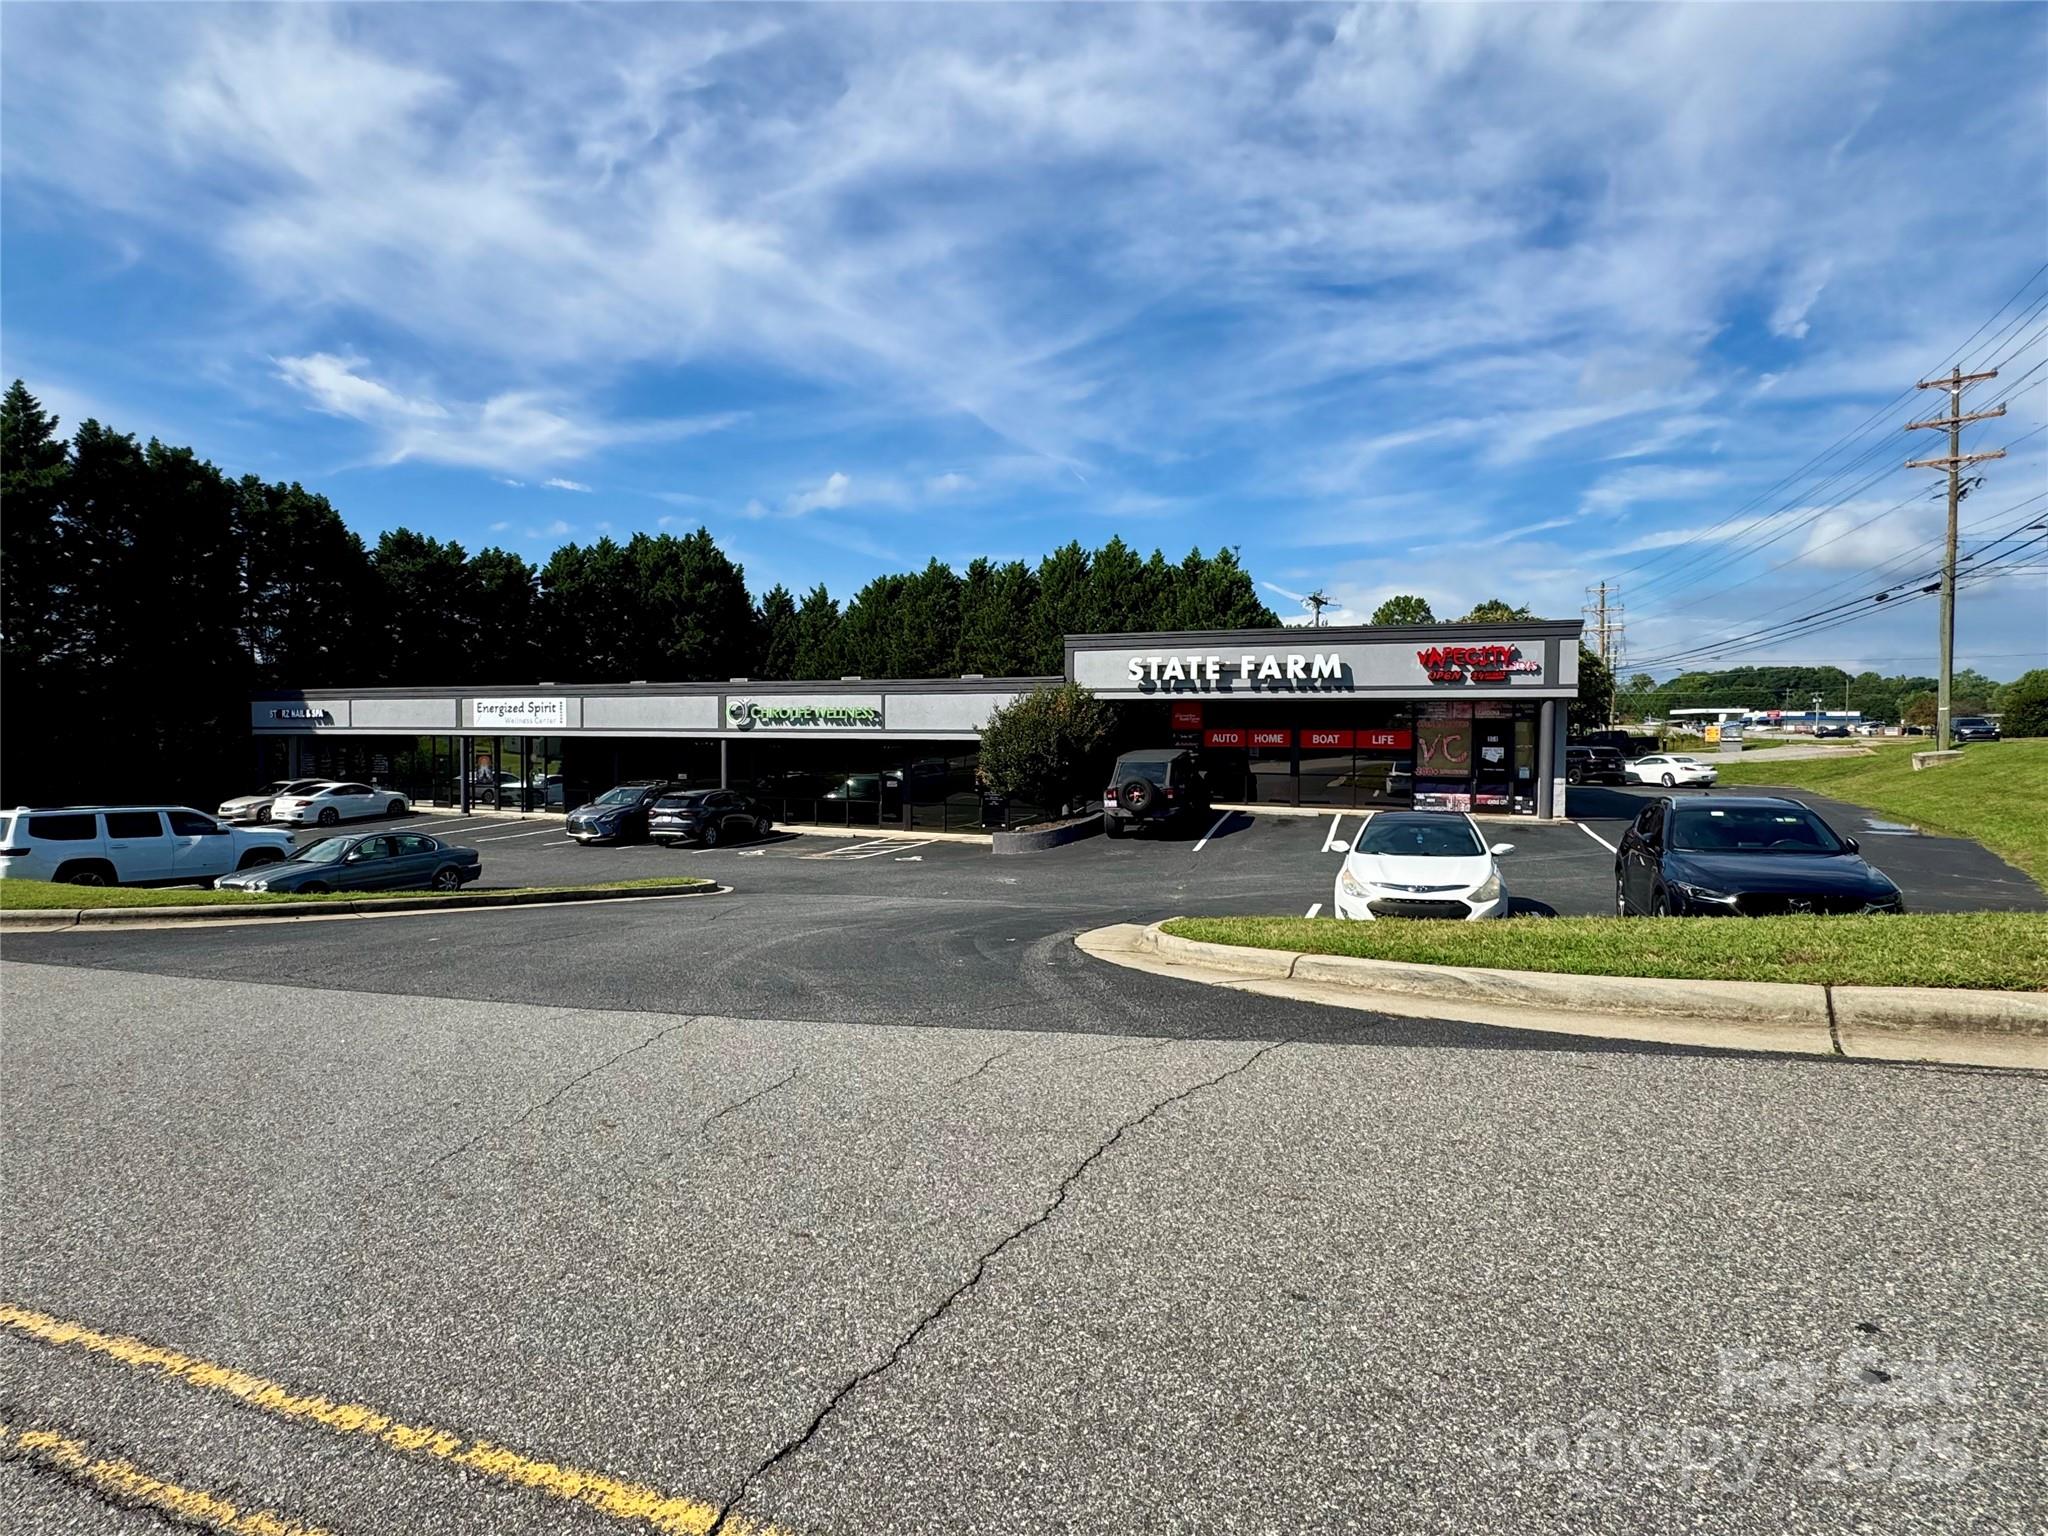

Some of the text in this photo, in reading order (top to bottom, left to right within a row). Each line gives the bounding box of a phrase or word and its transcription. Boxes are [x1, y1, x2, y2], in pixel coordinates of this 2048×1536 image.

[1128, 653, 1342, 681] STATE FARM
[270, 709, 324, 719] STRZ NAIL & SPA
[476, 701, 557, 717] Energized Spirit
[815, 706, 876, 719] WELLNESS
[505, 717, 557, 725] Wellness Center
[1212, 733, 1239, 744] AUTO
[1254, 733, 1284, 744] HOME
[1312, 734, 1341, 745] BOAT
[1371, 734, 1395, 745] LIFE
